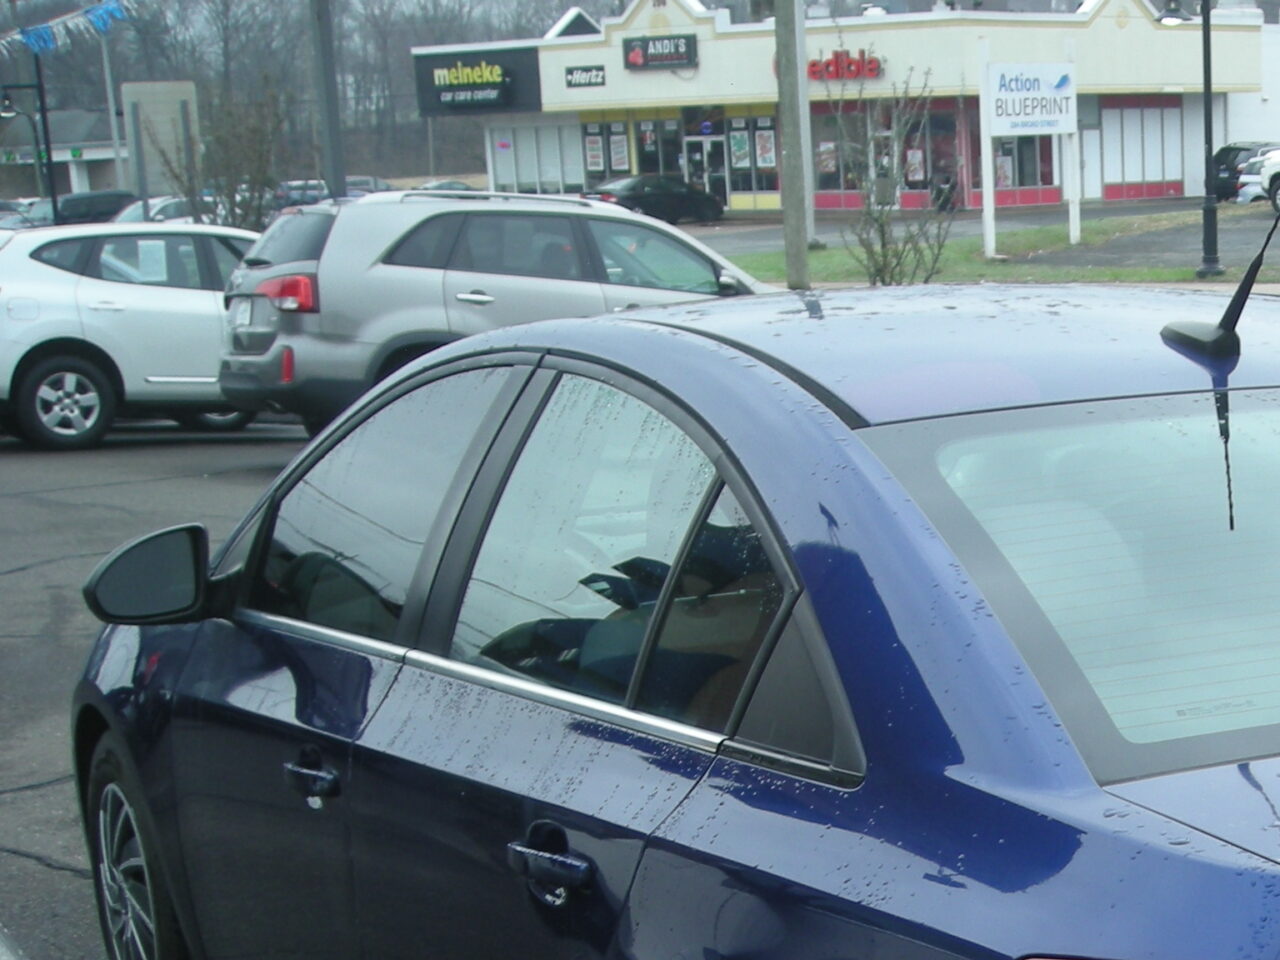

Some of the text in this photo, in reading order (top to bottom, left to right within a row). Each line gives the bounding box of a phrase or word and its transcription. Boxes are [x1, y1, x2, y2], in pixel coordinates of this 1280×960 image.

[647, 38, 687, 54] ANDI'S
[433, 60, 503, 85] meineke
[571, 69, 604, 85] Hertz
[998, 73, 1041, 92] Action
[440, 89, 499, 102] car care center
[995, 96, 1072, 117] BLUEPRINT
